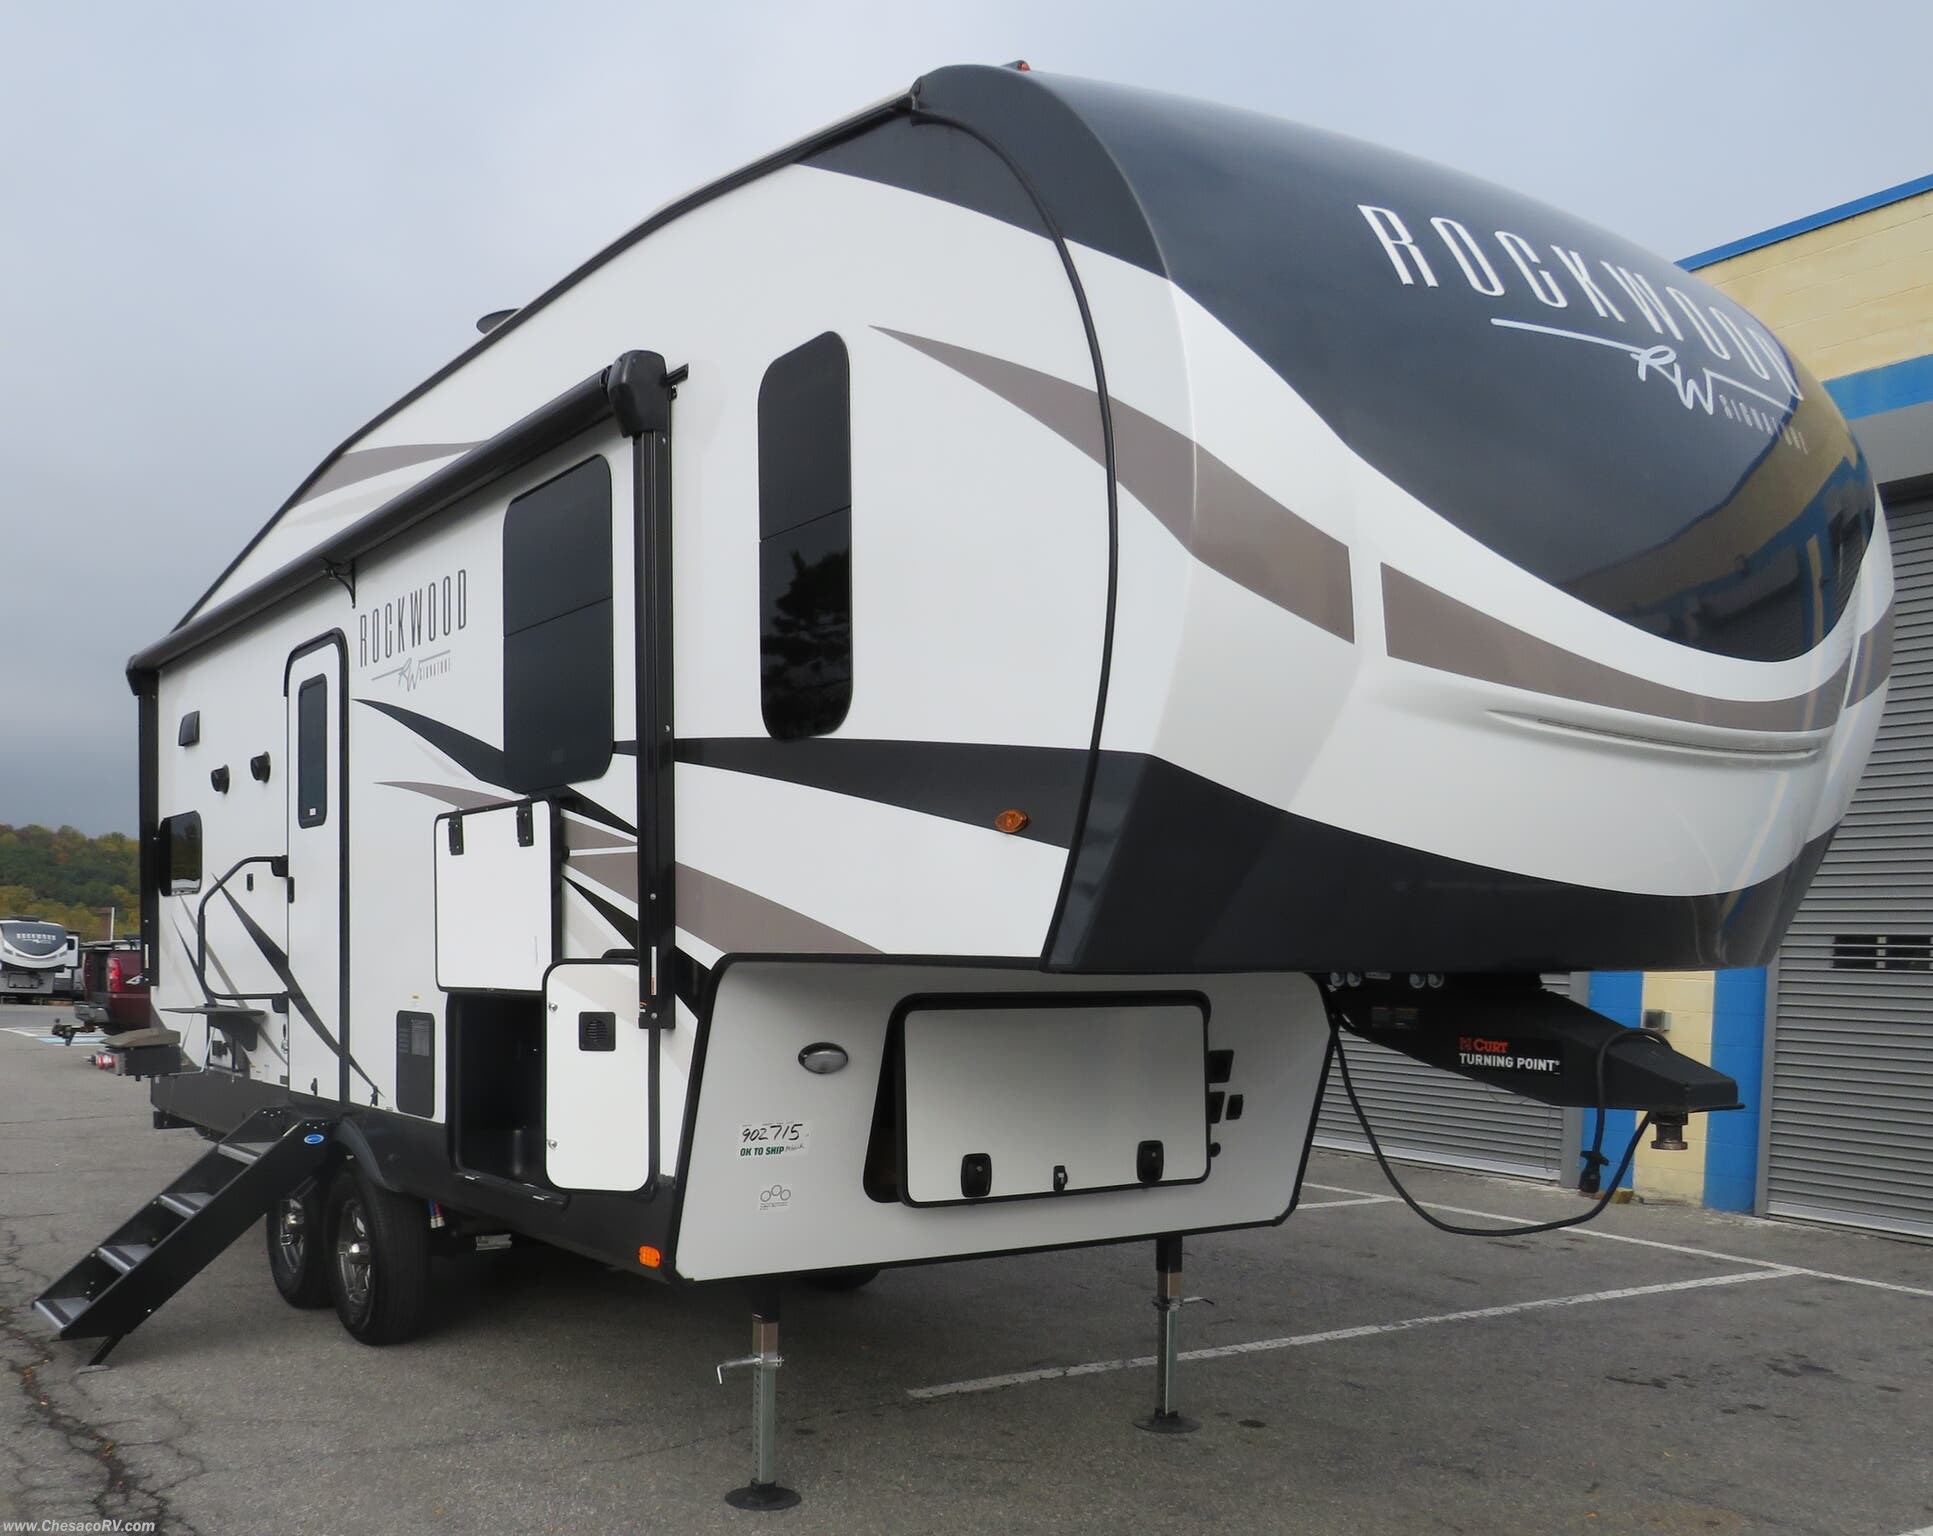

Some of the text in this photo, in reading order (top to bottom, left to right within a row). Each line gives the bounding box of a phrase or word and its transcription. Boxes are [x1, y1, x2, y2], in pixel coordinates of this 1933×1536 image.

[1357, 203, 1804, 401] ROCKWOOD
[360, 569, 466, 668] ROCKWOOD
[1459, 1052, 1514, 1068] TURNING
[742, 1123, 803, 1143] 902715
[740, 1148, 751, 1156] OK
[754, 1147, 763, 1155] TO
[765, 1146, 784, 1155] SHIP
